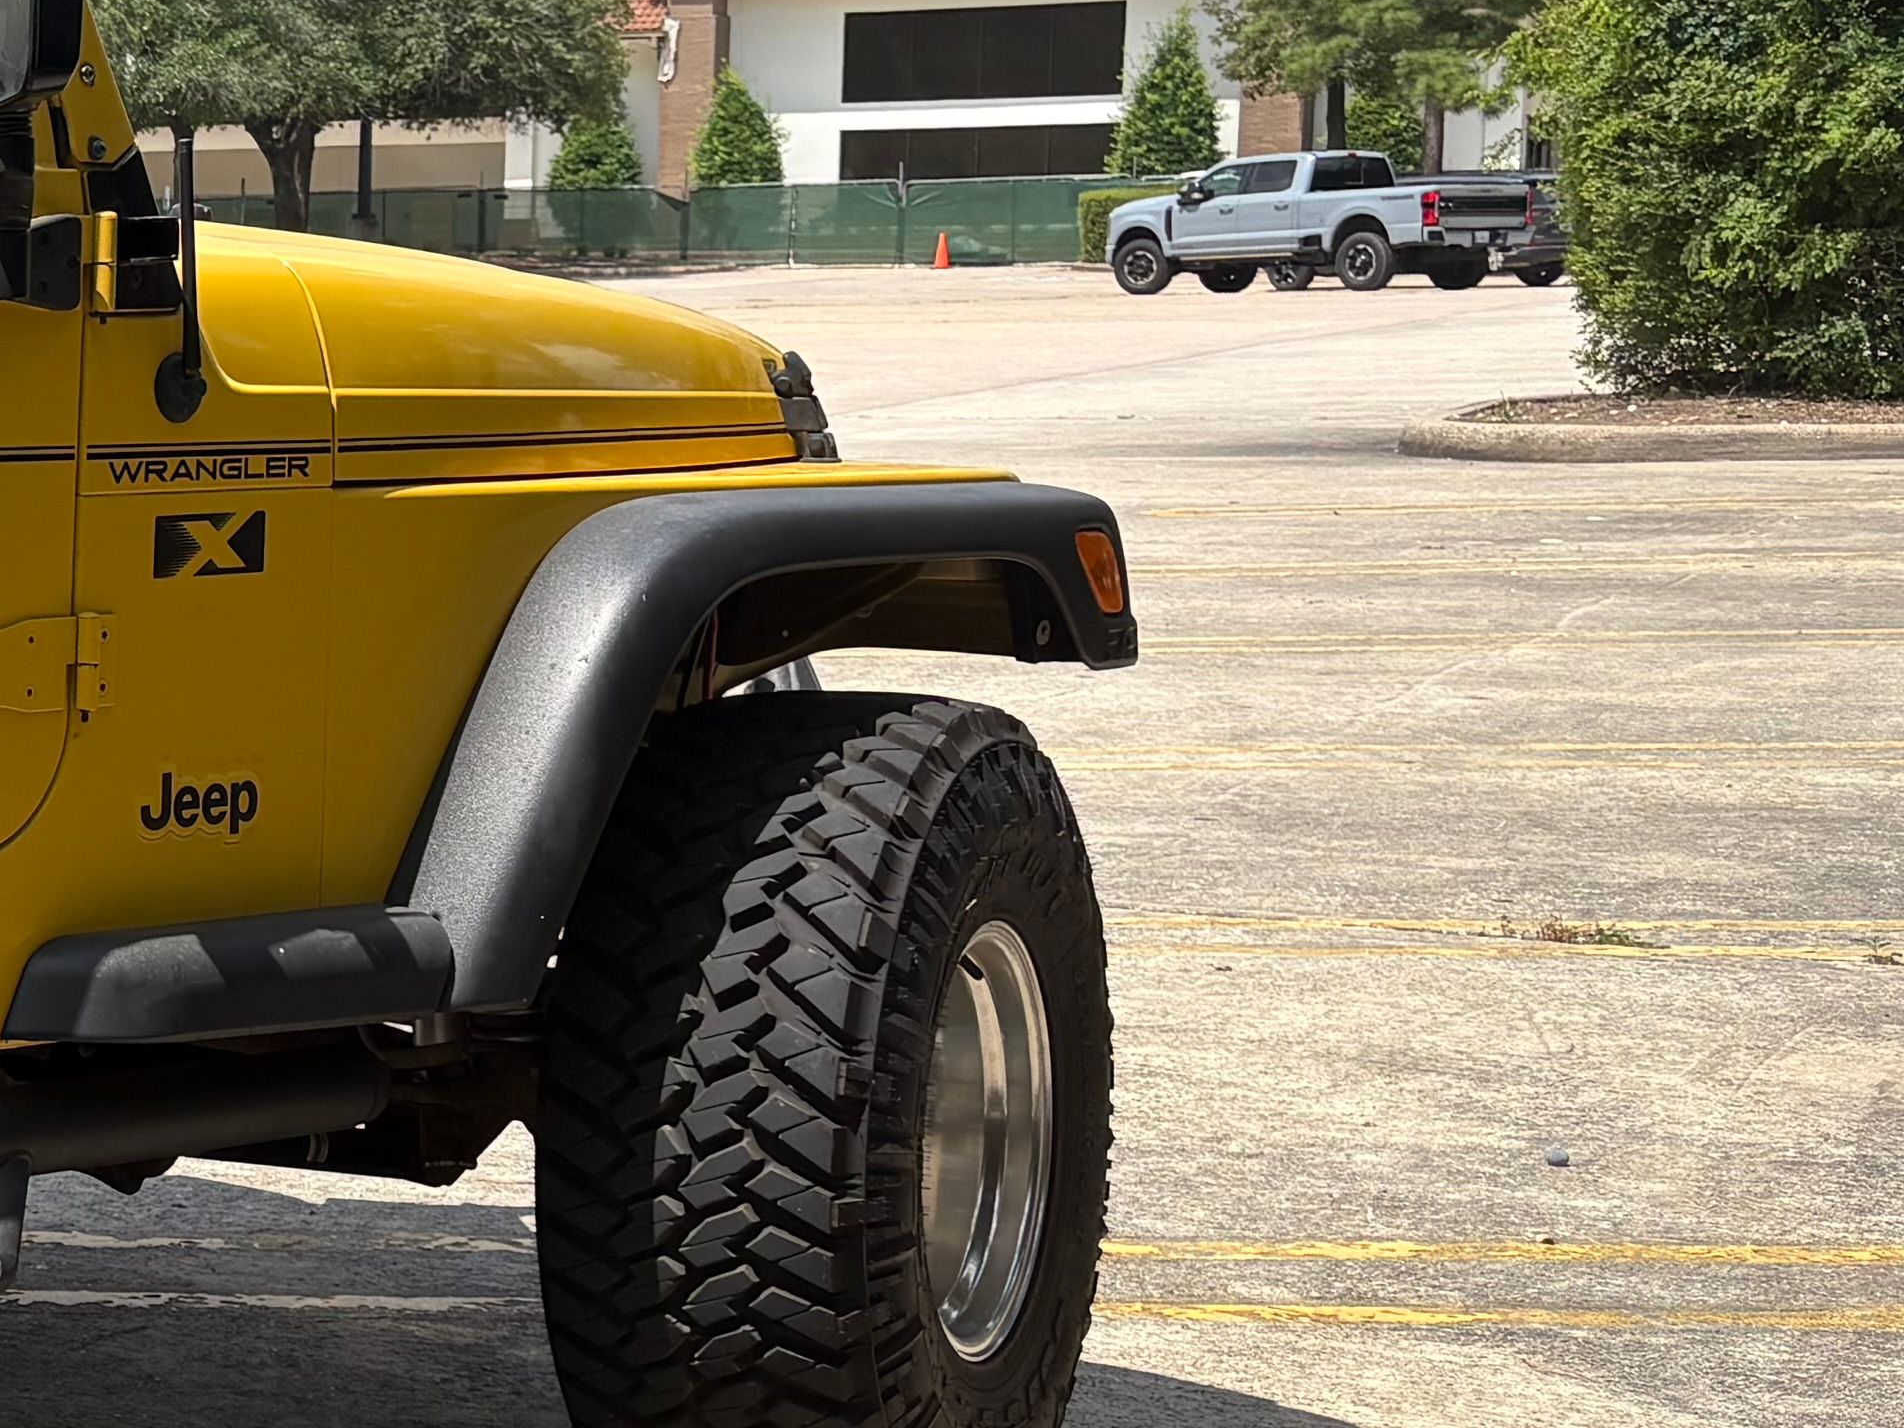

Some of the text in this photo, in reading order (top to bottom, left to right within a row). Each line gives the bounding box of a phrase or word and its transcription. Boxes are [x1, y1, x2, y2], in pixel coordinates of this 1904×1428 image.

[109, 456, 310, 484] WRANGLER
[166, 509, 259, 578] X
[140, 771, 258, 835] Jeep
